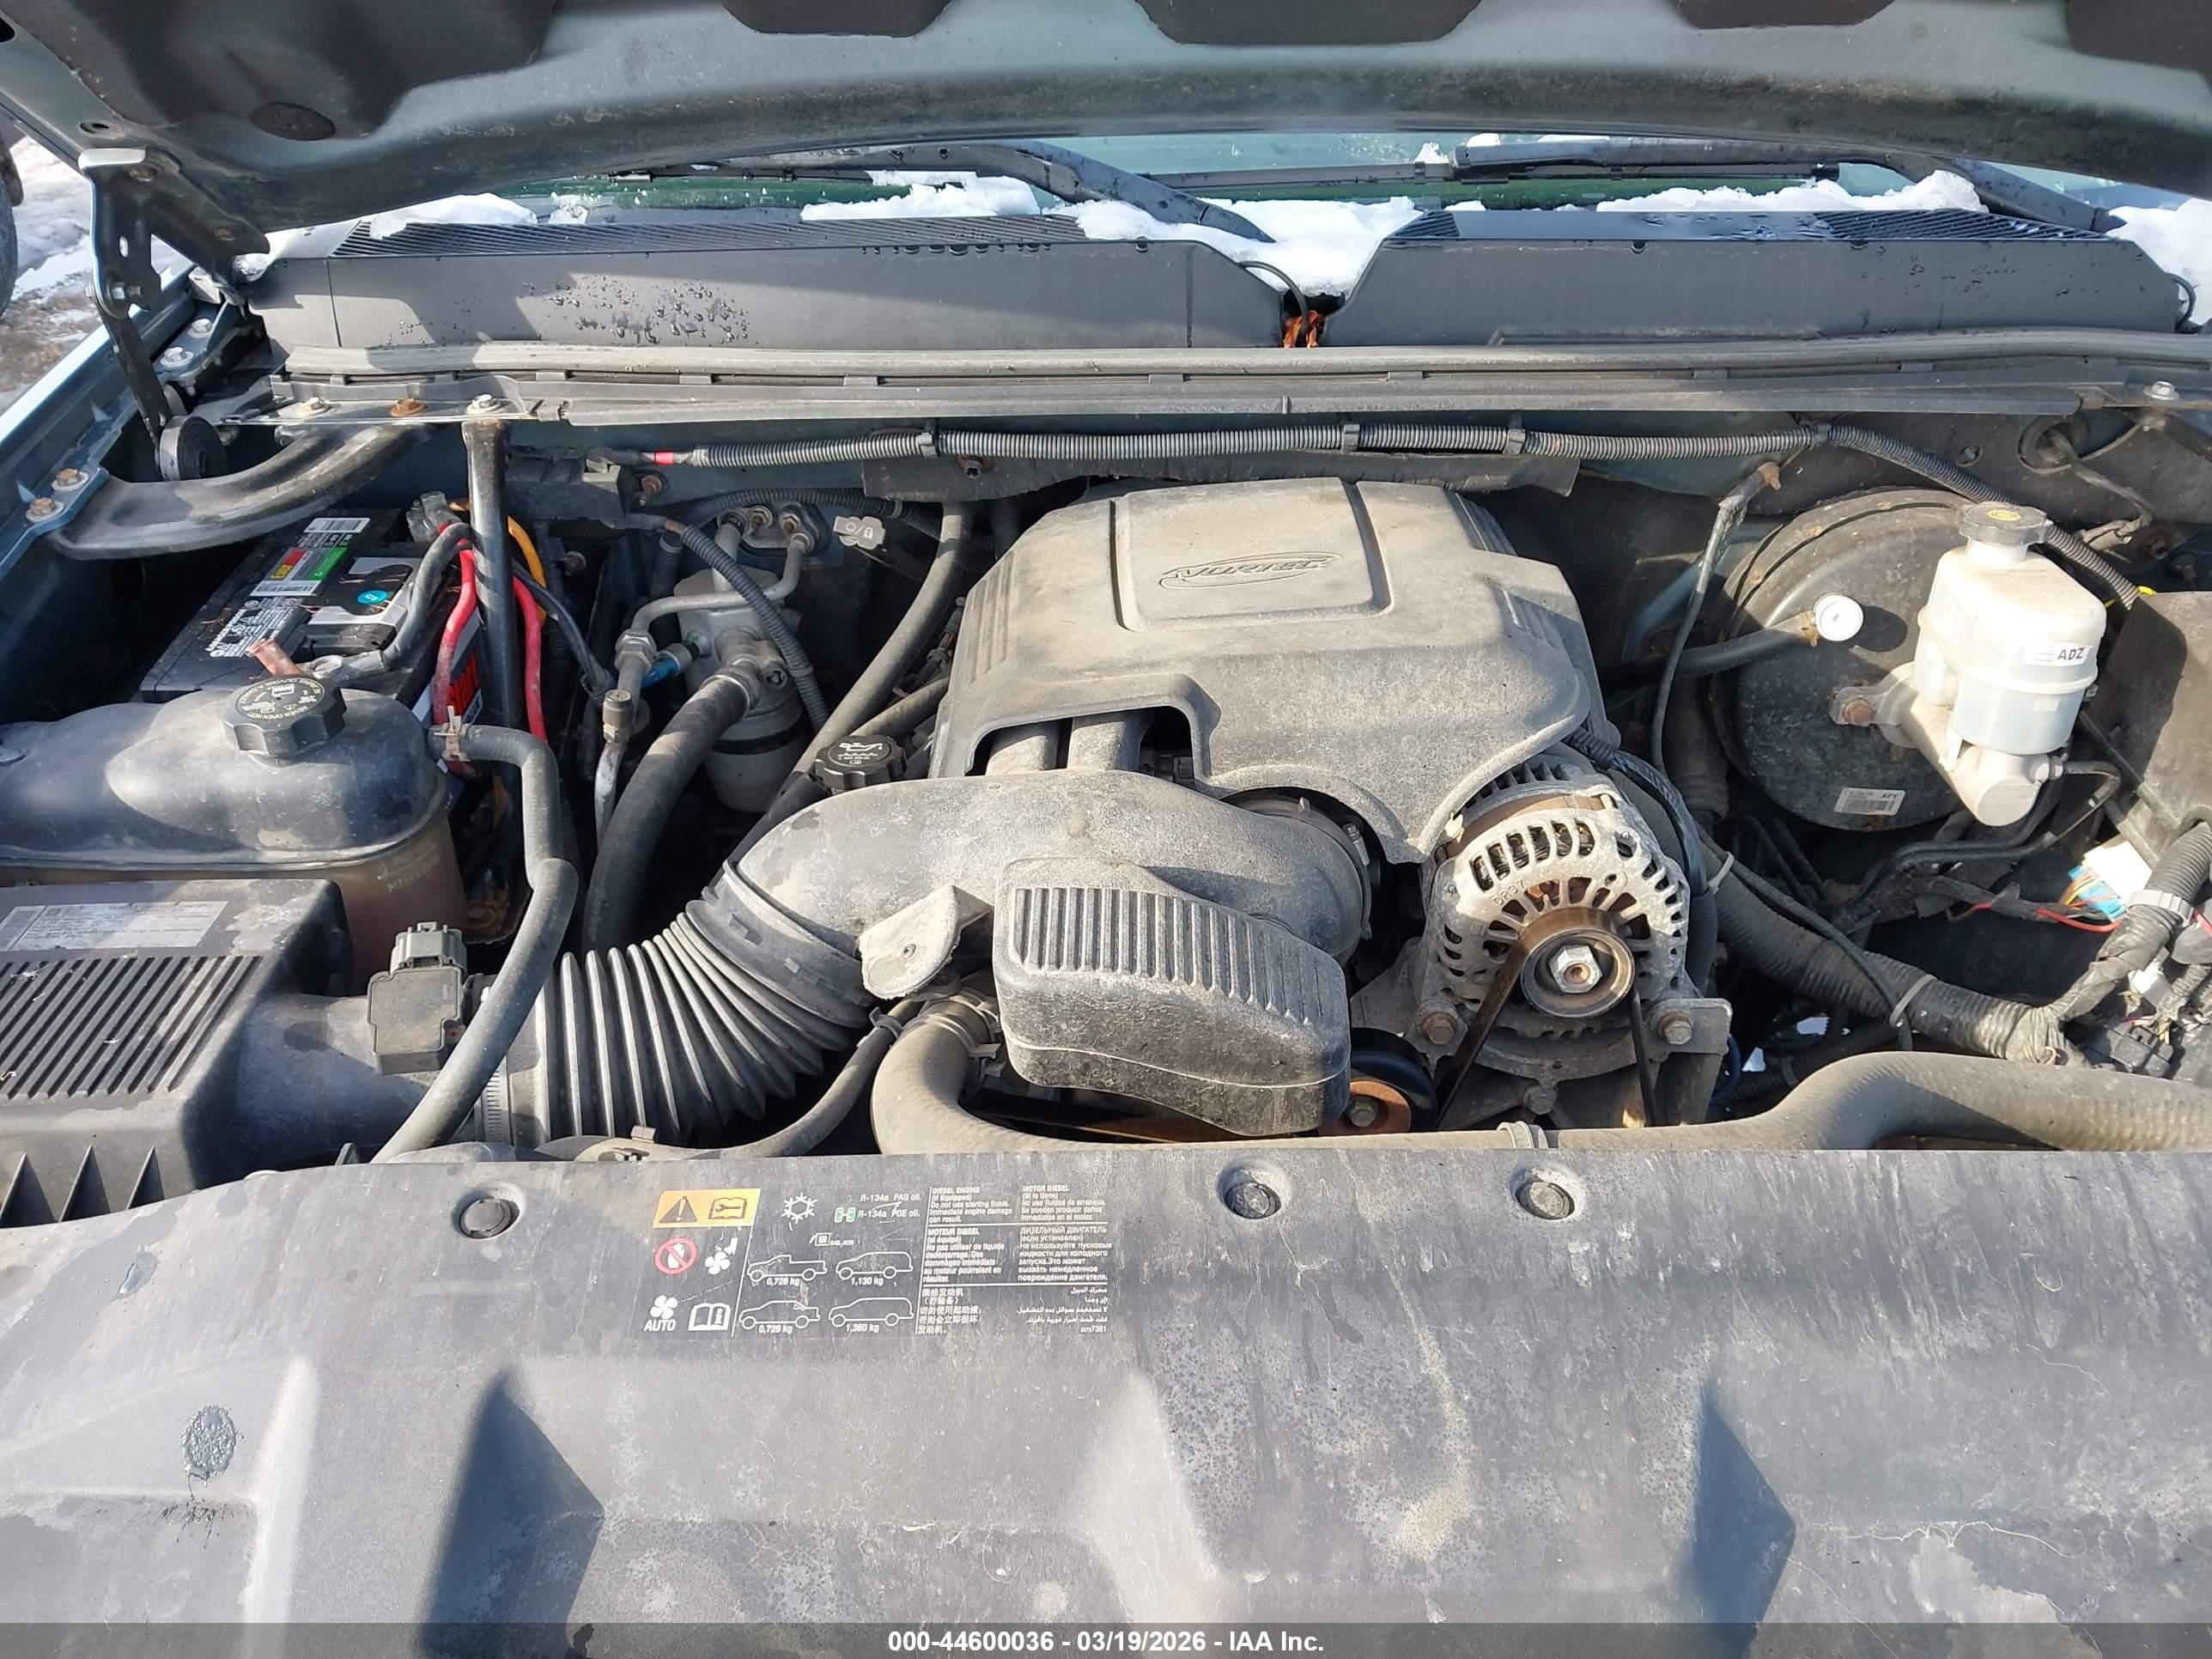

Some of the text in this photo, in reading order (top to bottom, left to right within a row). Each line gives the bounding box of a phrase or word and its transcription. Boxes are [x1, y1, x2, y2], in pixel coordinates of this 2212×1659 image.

[2057, 647, 2085, 660] ADZ
[957, 1227, 981, 1236] DIESEL
[1019, 1225, 1108, 1235] ДИЗЕЛЬНЫЙ ДВИГАТЕЛЬ
[789, 1277, 800, 1286] kg
[873, 1276, 884, 1286] kg
[644, 1319, 676, 1331] AUTO
[782, 1323, 793, 1334] kg
[869, 1323, 879, 1334] kg
